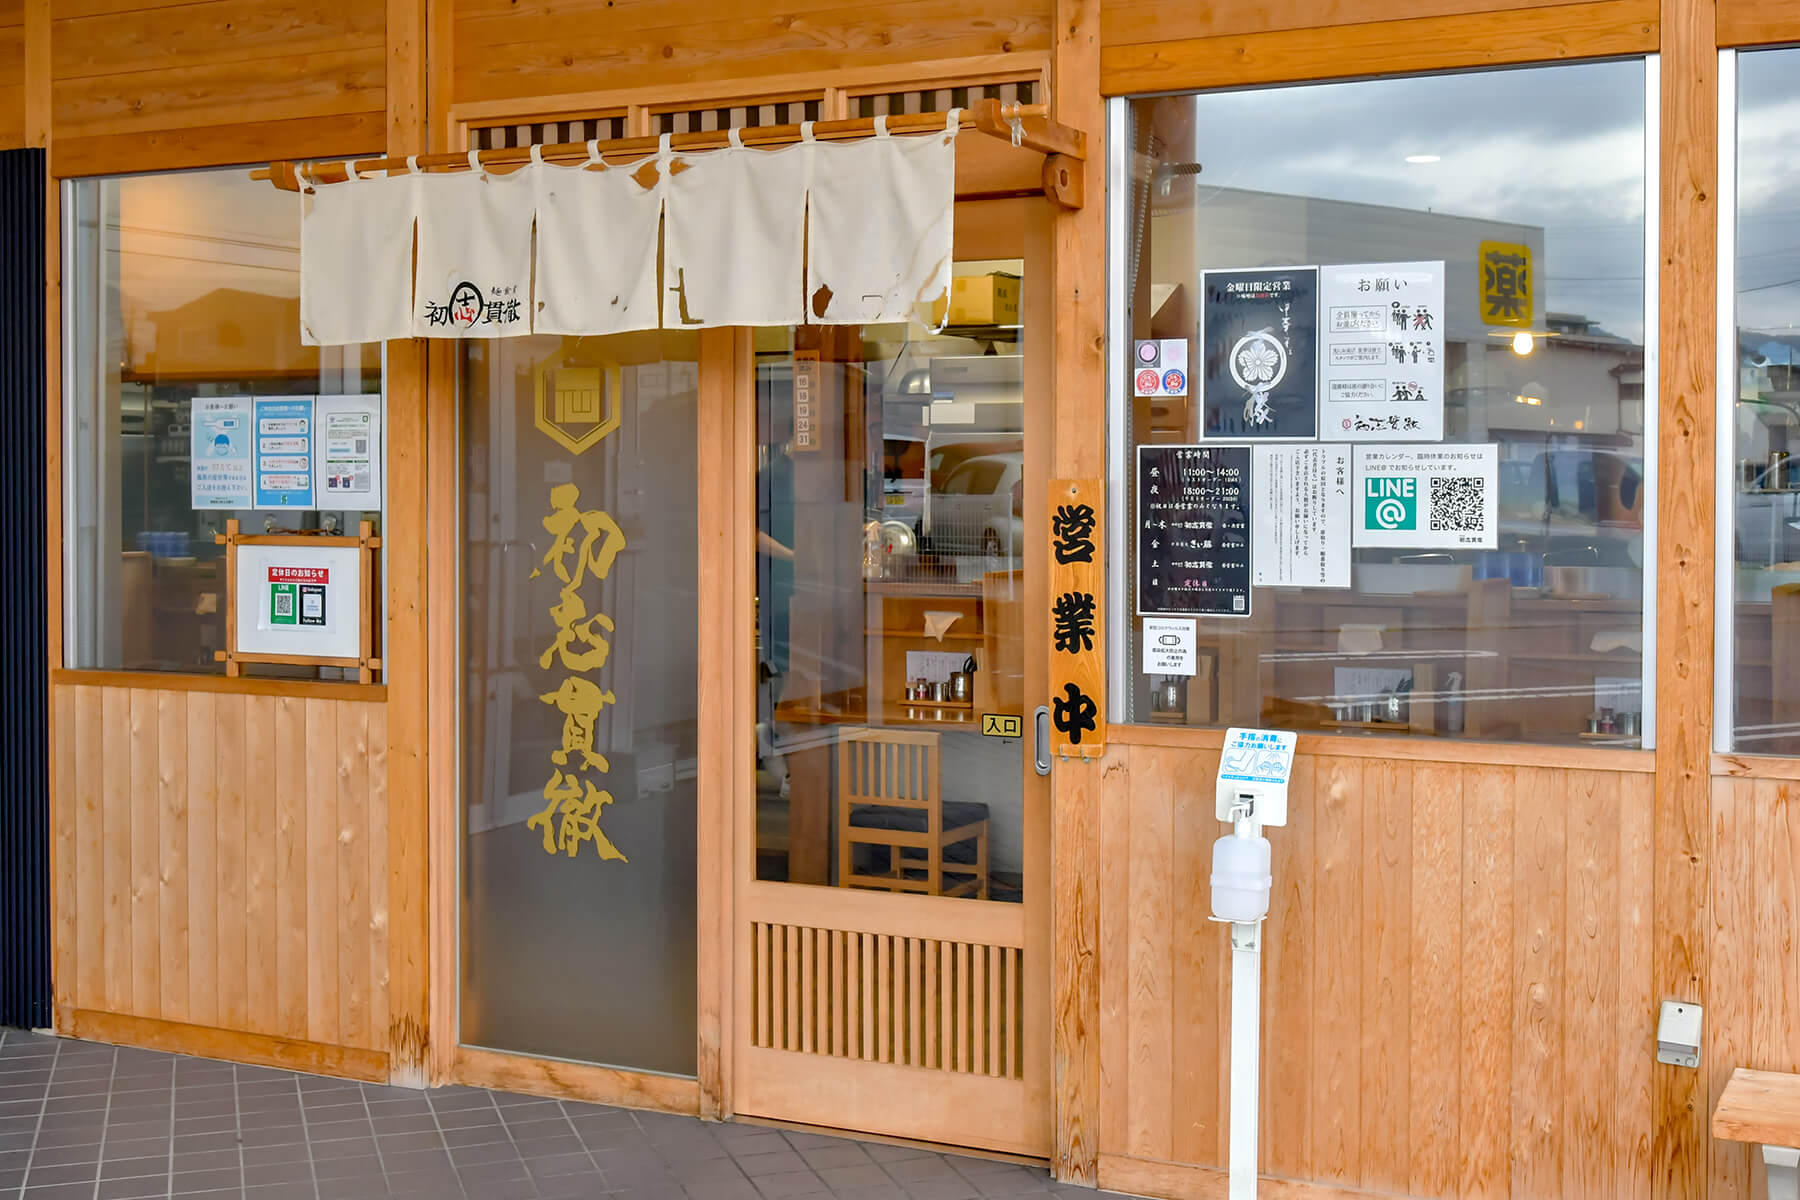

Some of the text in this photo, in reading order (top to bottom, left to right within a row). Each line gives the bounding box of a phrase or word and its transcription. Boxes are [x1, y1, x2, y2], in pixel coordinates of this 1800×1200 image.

[1225, 280, 1291, 292] 金曜日限定営業
[1357, 277, 1408, 292] お願い
[1336, 456, 1345, 496] お客様へ
[1367, 478, 1415, 498] LINE
[1375, 498, 1407, 529] @
[271, 568, 325, 578] 定休日のお知らせ
[1052, 504, 1097, 745] 営業中
[527, 483, 628, 863] 初志貫徹
[986, 717, 1017, 733] 入口
